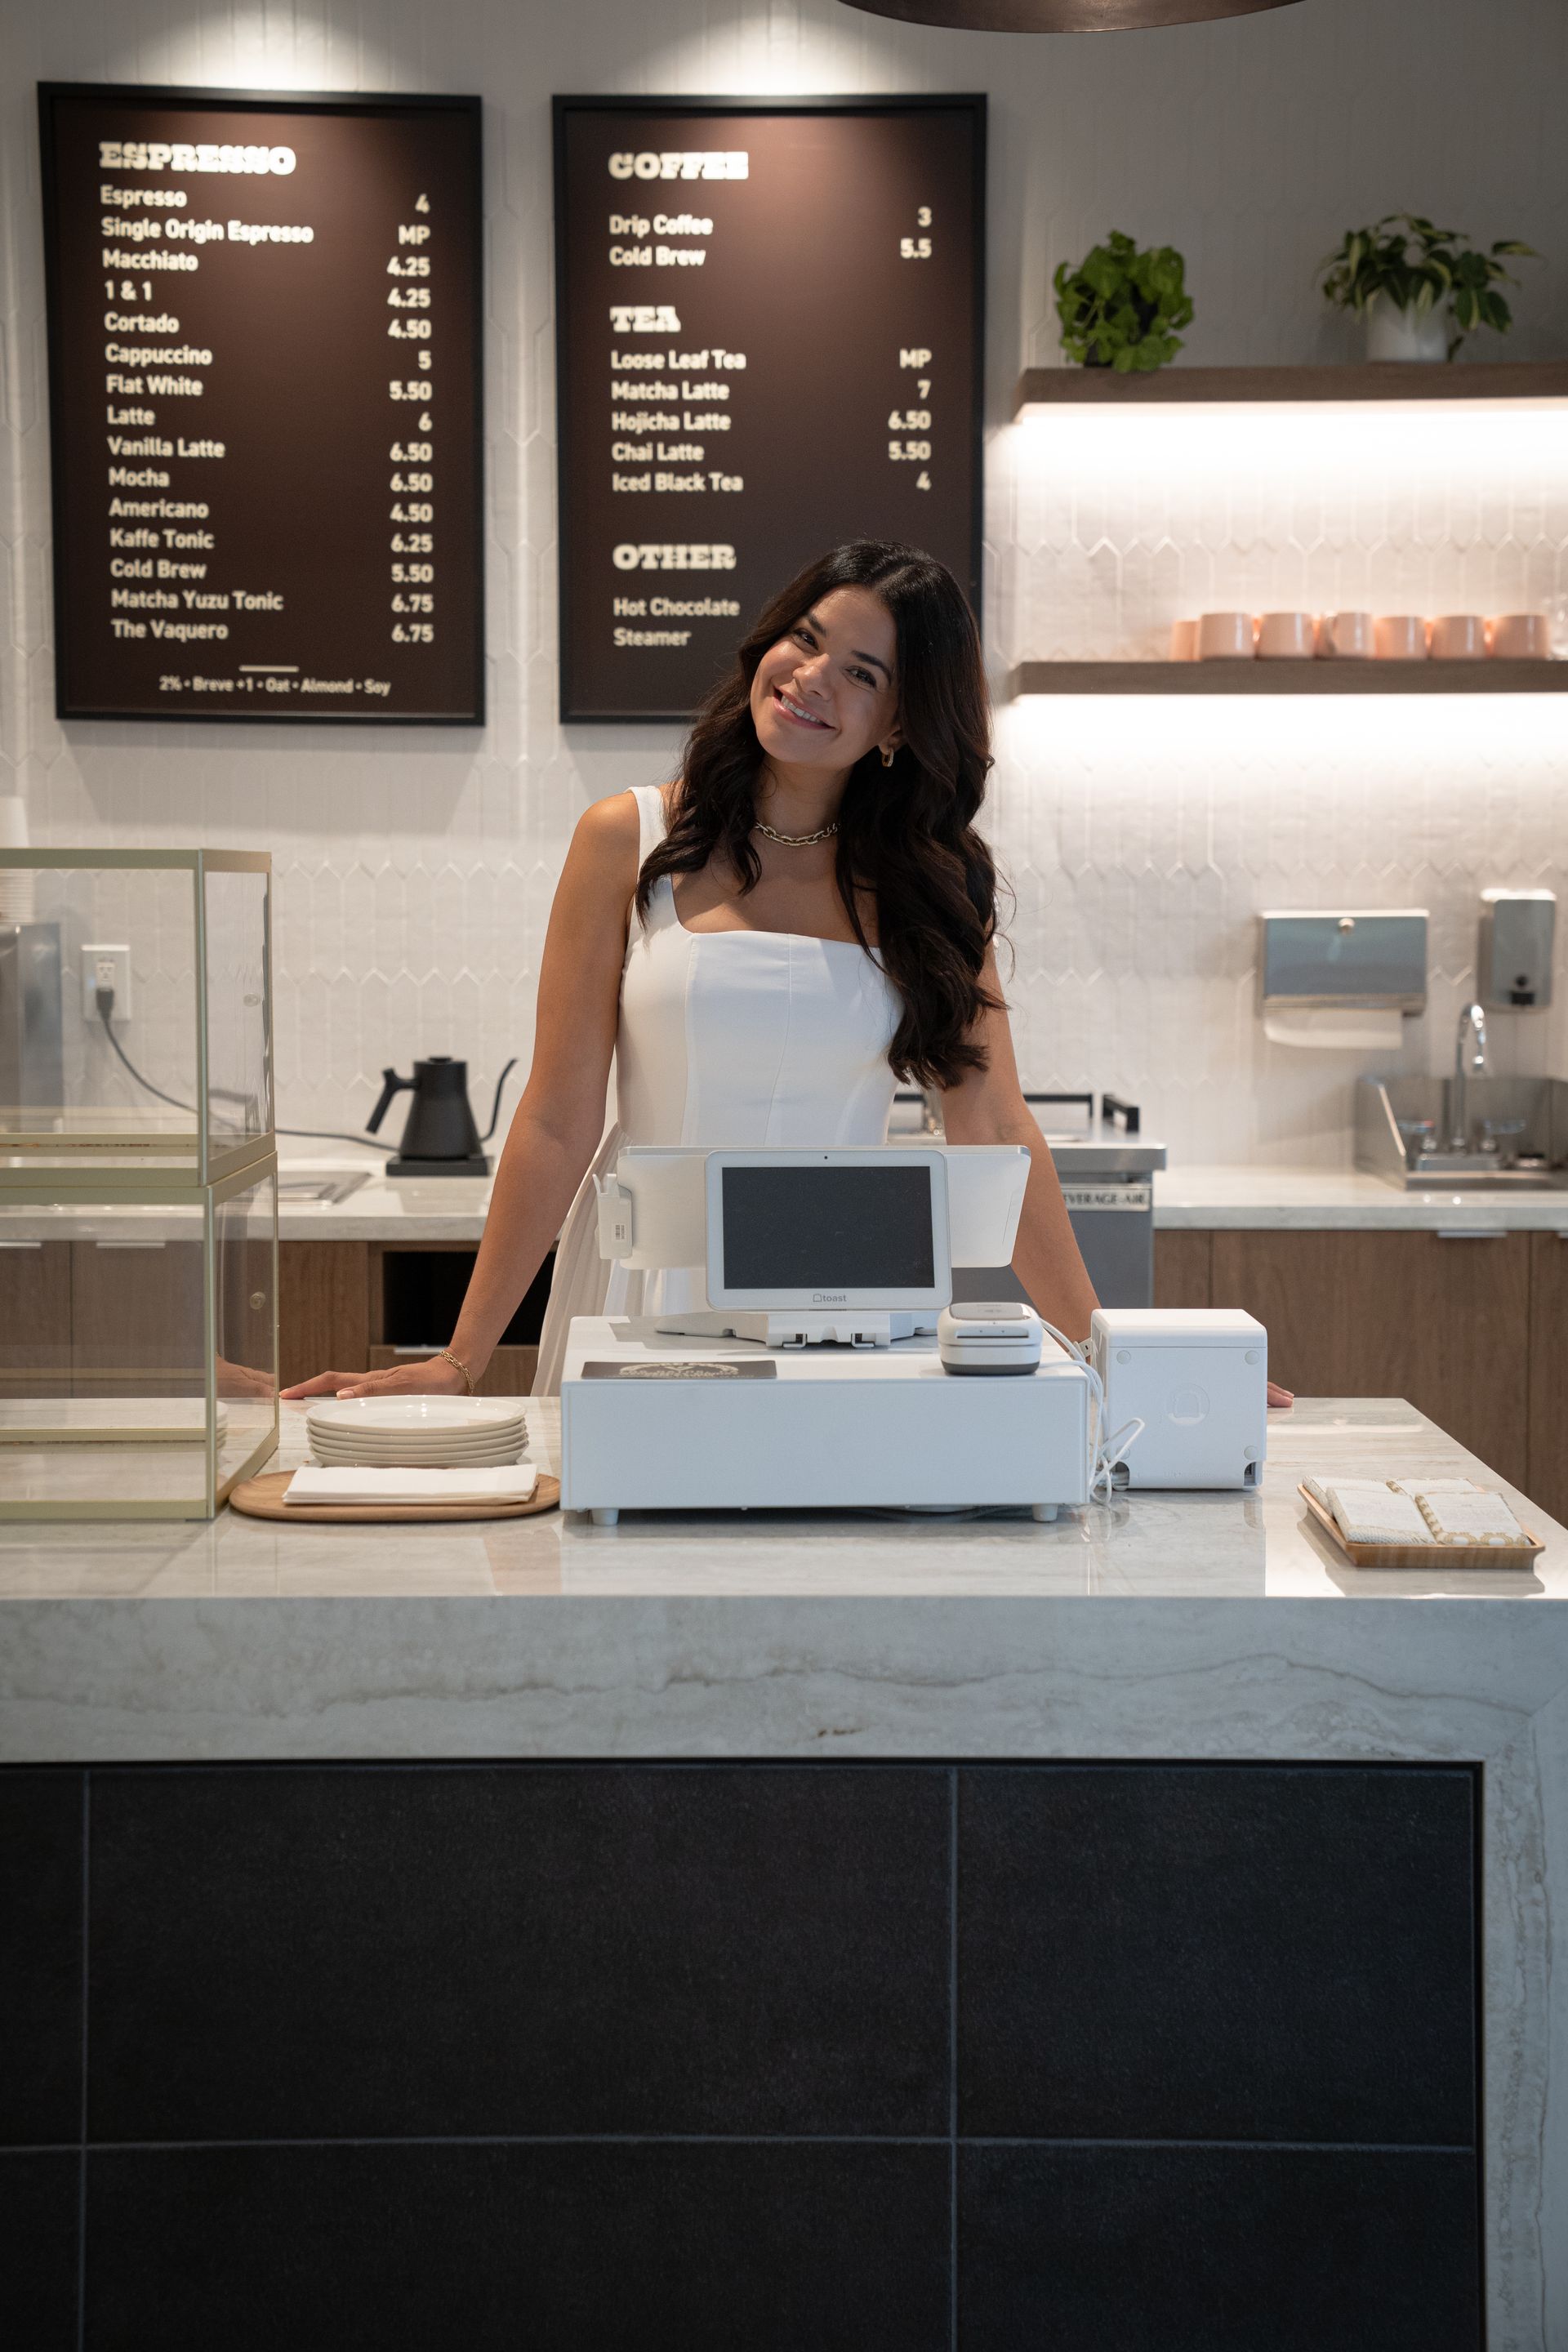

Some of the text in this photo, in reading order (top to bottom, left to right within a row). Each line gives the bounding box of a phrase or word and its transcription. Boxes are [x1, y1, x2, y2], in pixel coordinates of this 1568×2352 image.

[99, 142, 296, 175] ESPRESSO
[608, 151, 749, 180] COFFEE
[101, 185, 430, 213] Espresso 4
[102, 217, 430, 245] Single Origin Espresso MP
[610, 207, 931, 238] Drip Coffee 3
[103, 249, 430, 276] Macchiato 4.25
[609, 238, 931, 266] Cold Brew 5.5
[105, 280, 430, 307] 1 & 1 4.25
[105, 312, 431, 339] Cortado 4.50
[610, 306, 681, 332] TEA
[105, 343, 431, 370] Cappuccino 5
[611, 349, 931, 369] Loose Leaf Tea MP
[107, 374, 432, 400] Flat White 5.50
[612, 380, 931, 400] Matcha Latte 7
[107, 405, 432, 431] Latte 6
[612, 411, 931, 434] Hojicha Latte 6.50
[107, 436, 432, 461] Vanilla Latte 6.50
[612, 441, 931, 461] Chai Latte 5.50
[109, 467, 433, 492] Mocha 6.50
[612, 472, 931, 492] Iced Black Tea 4
[109, 498, 433, 522] Americano 4.50
[110, 528, 433, 552] Kaffe Tonic 6.25
[613, 545, 736, 569] OTHER
[110, 559, 434, 582] Cold Brew 5.50
[112, 589, 434, 612] Matcha Yuzu Tonic 6.75
[613, 598, 740, 616] Hot Chocolate
[111, 619, 434, 642] The Vaquero 6.75
[614, 627, 691, 646] Steamer
[193, 676, 234, 692] Breve
[301, 679, 354, 693] Almond
[364, 679, 390, 696] Soy
